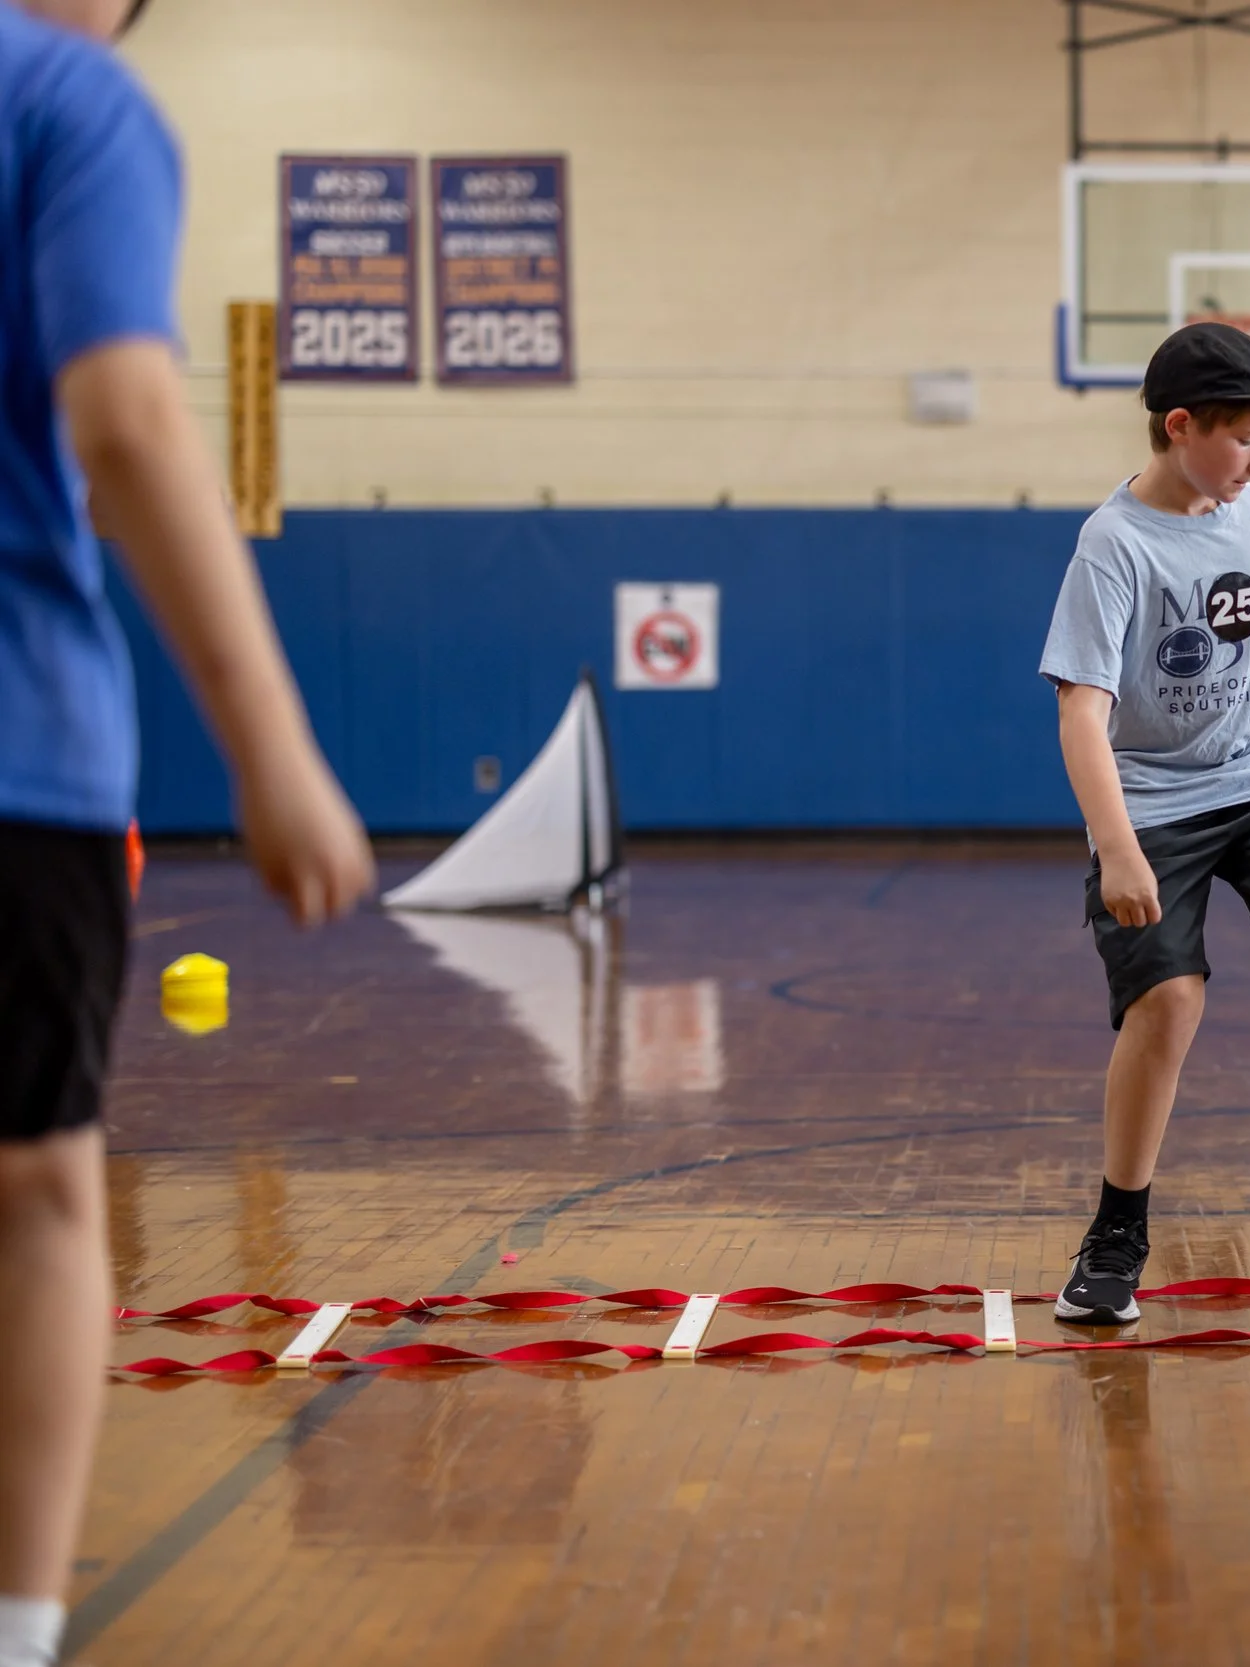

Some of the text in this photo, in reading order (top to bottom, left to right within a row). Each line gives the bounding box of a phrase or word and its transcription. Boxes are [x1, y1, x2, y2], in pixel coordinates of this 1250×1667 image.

[291, 311, 407, 366] 2025
[444, 311, 562, 367] 2026
[1159, 578, 1207, 628] M
[1158, 682, 1219, 698] PRIDE
